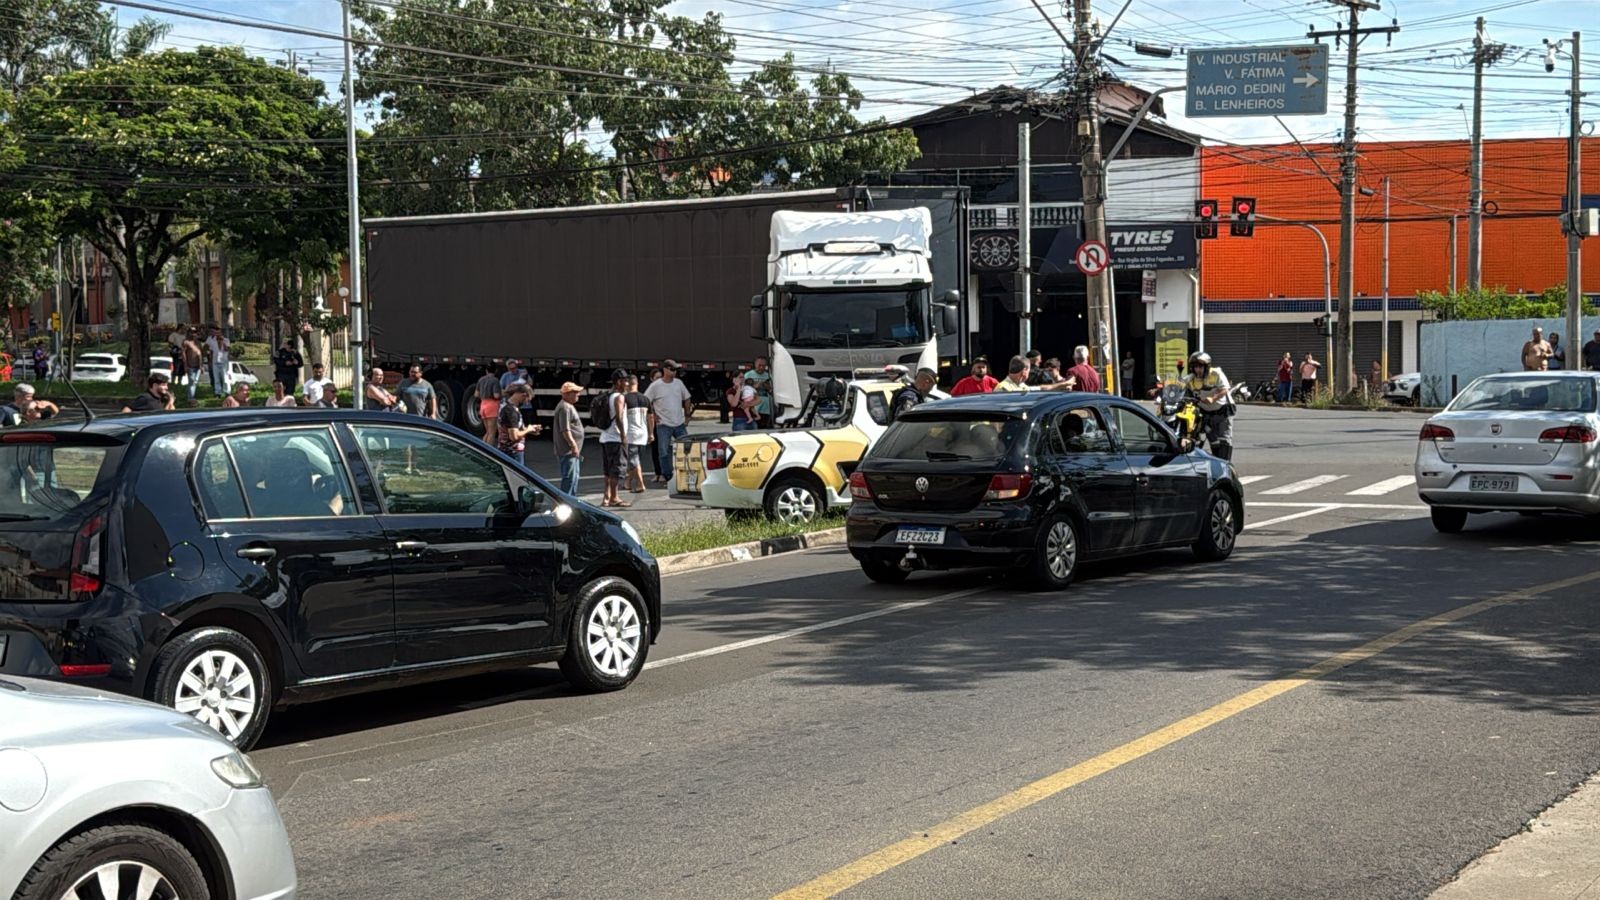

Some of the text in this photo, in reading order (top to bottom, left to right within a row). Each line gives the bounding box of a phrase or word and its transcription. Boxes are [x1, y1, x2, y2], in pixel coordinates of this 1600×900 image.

[1196, 52, 1286, 65] V. INDUSTRIAL
[1224, 66, 1285, 79] V. FÁTIMA
[1196, 83, 1286, 96] MÁRIO DEDINI
[1195, 98, 1285, 111] B. LENHEIROS
[1110, 230, 1174, 245] TYRES
